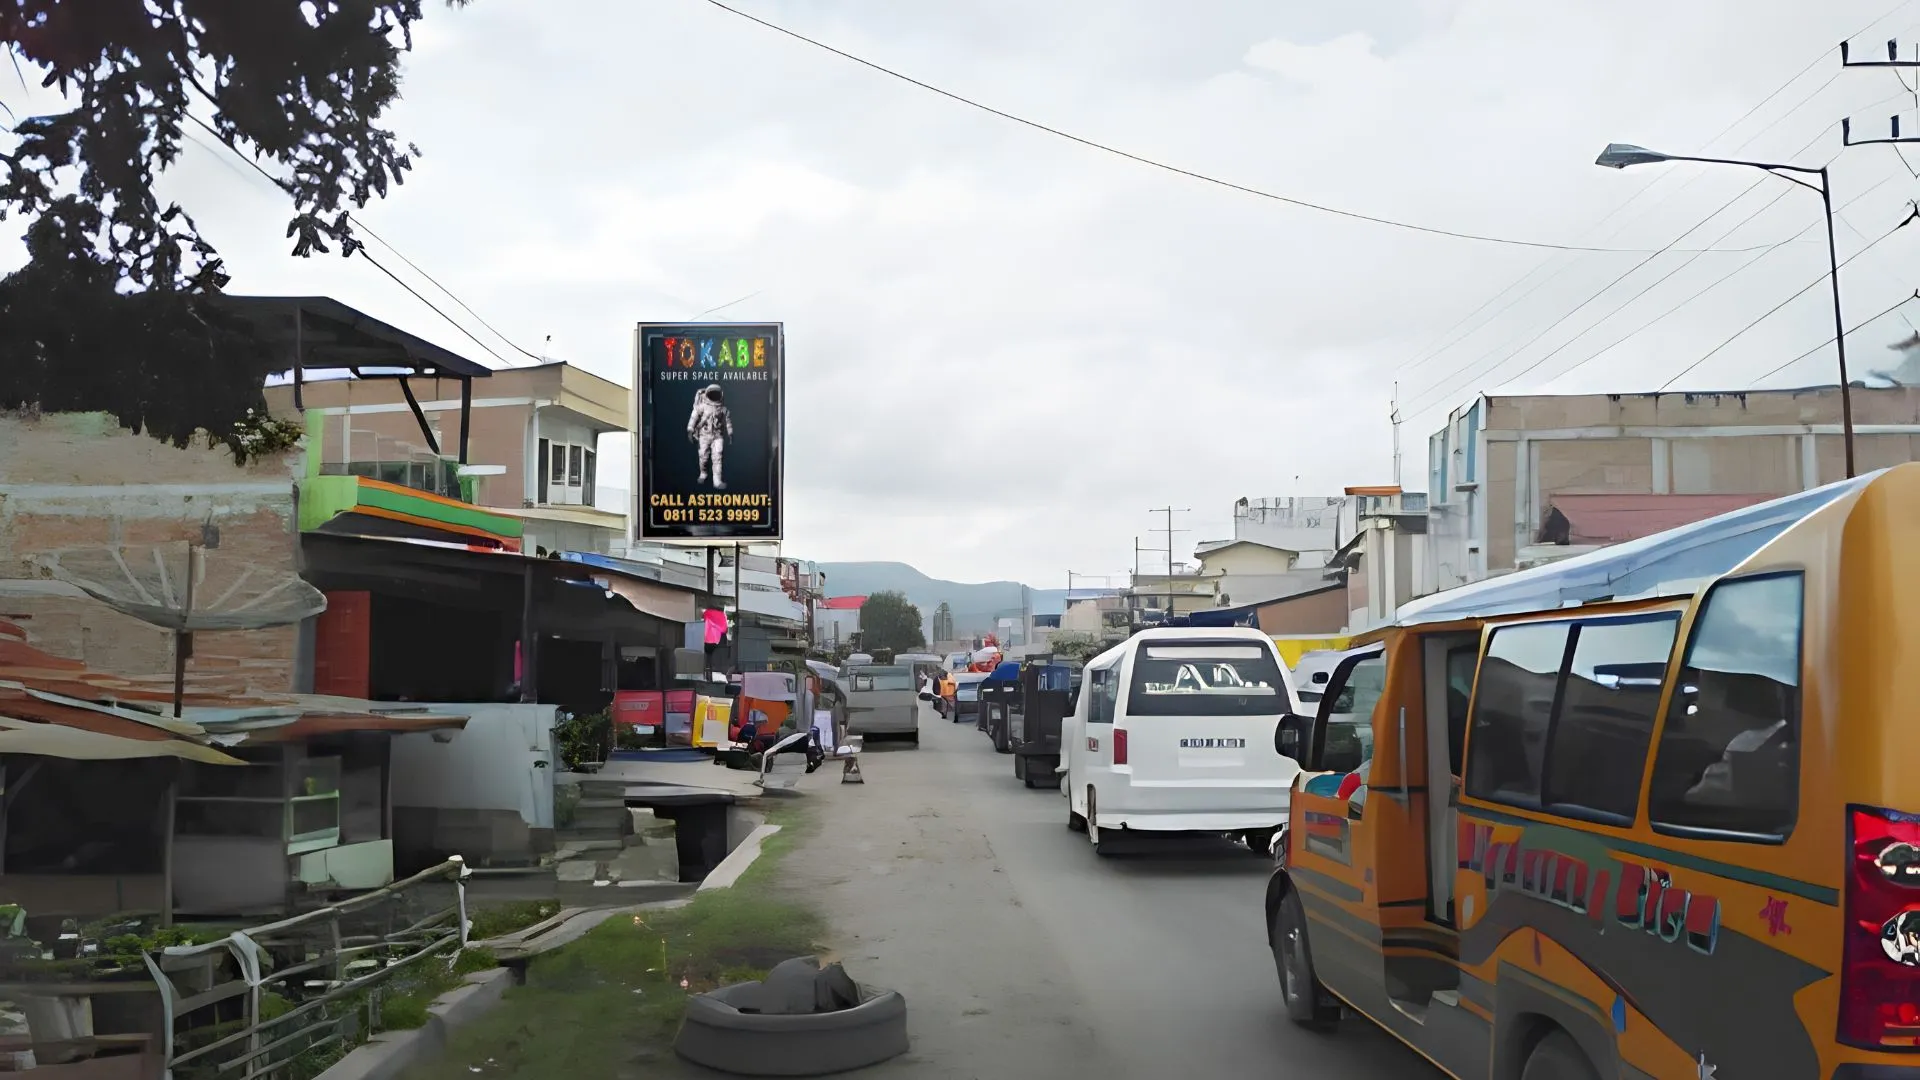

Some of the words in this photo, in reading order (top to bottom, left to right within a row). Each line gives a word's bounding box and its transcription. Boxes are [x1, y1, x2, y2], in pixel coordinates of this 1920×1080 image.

[663, 336, 765, 368] TOKABE
[661, 371, 688, 381] SUPER
[692, 371, 719, 381] SPACE
[723, 371, 768, 381] AVAILABLE
[650, 494, 684, 506] CALL
[687, 494, 772, 507] ASTRONAUT:
[663, 509, 694, 521] 0811
[698, 509, 723, 521] 523
[727, 509, 760, 521] 9999
